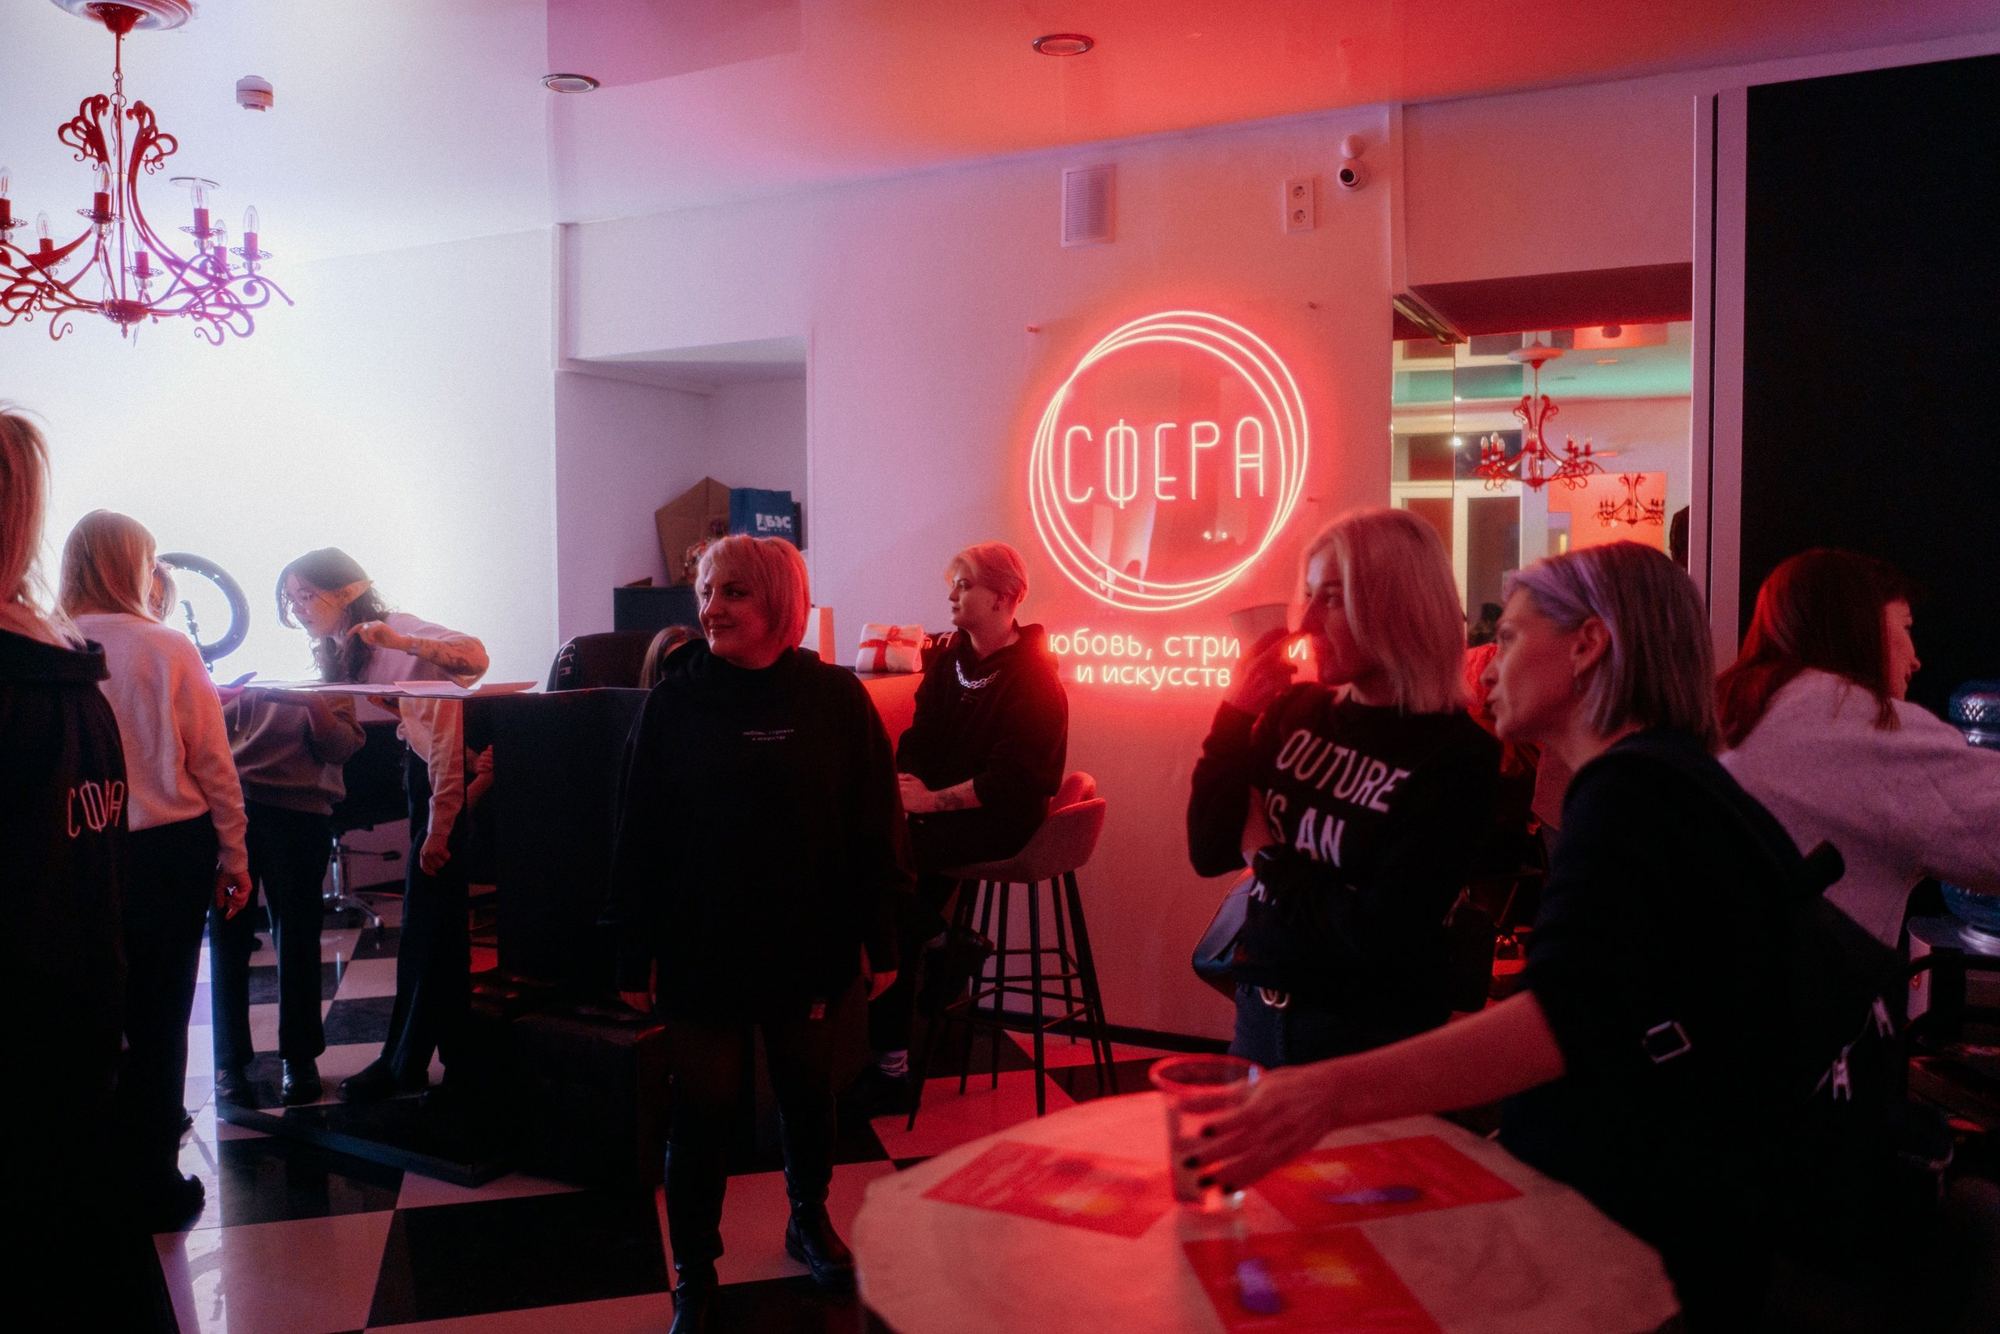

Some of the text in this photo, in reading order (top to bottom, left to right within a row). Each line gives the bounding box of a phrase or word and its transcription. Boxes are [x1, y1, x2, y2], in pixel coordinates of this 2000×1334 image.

[1063, 416, 1265, 510] СФЕРА
[1048, 628, 1154, 661] юбовь,
[1076, 663, 1232, 692] и искусств
[1275, 728, 1412, 814] OUTURE
[1294, 806, 1345, 868] AN
